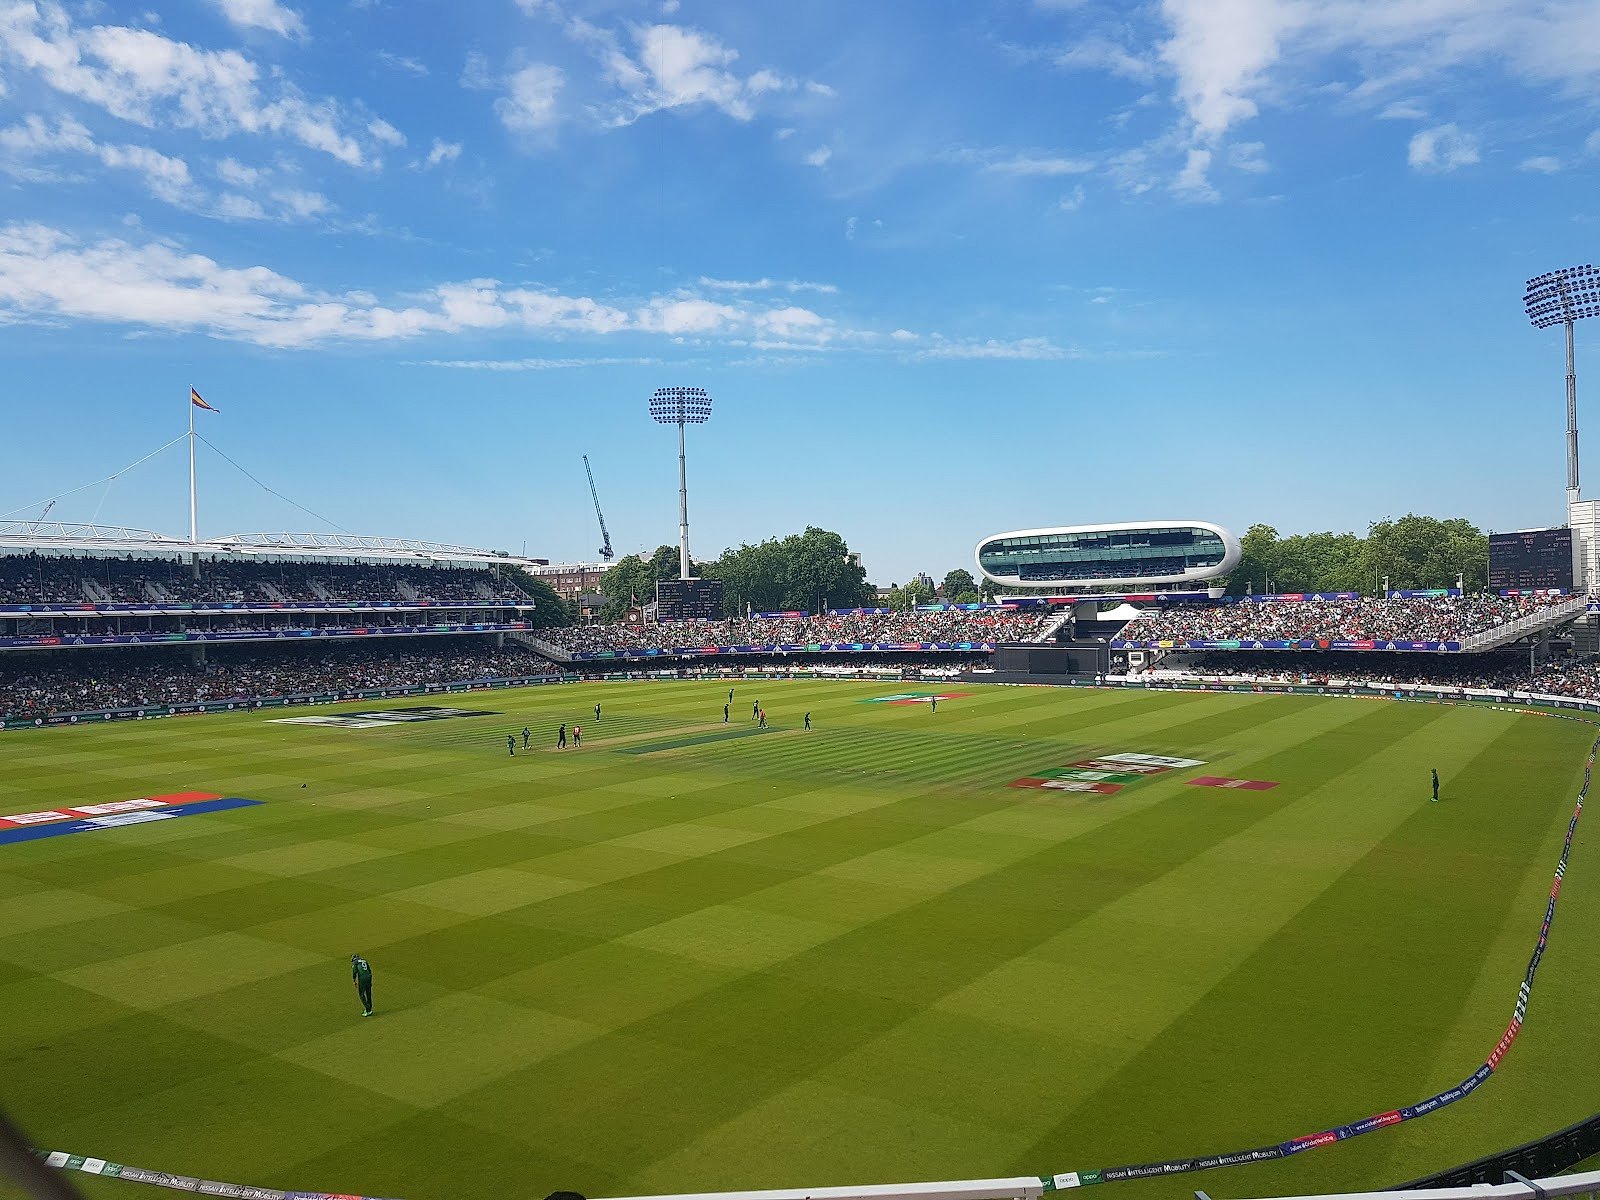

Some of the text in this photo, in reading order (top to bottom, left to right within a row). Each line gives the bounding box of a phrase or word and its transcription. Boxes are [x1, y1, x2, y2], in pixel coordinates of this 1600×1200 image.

[1199, 1150, 1278, 1168] NISSAN INTELLIGENT MOBILITY
[1083, 1173, 1097, 1181] oppo
[1106, 1163, 1191, 1179] NISSAN INTELLIGENT MOBILITY
[170, 1177, 196, 1189] MOBILITY
[199, 1184, 220, 1192] NISSAN
